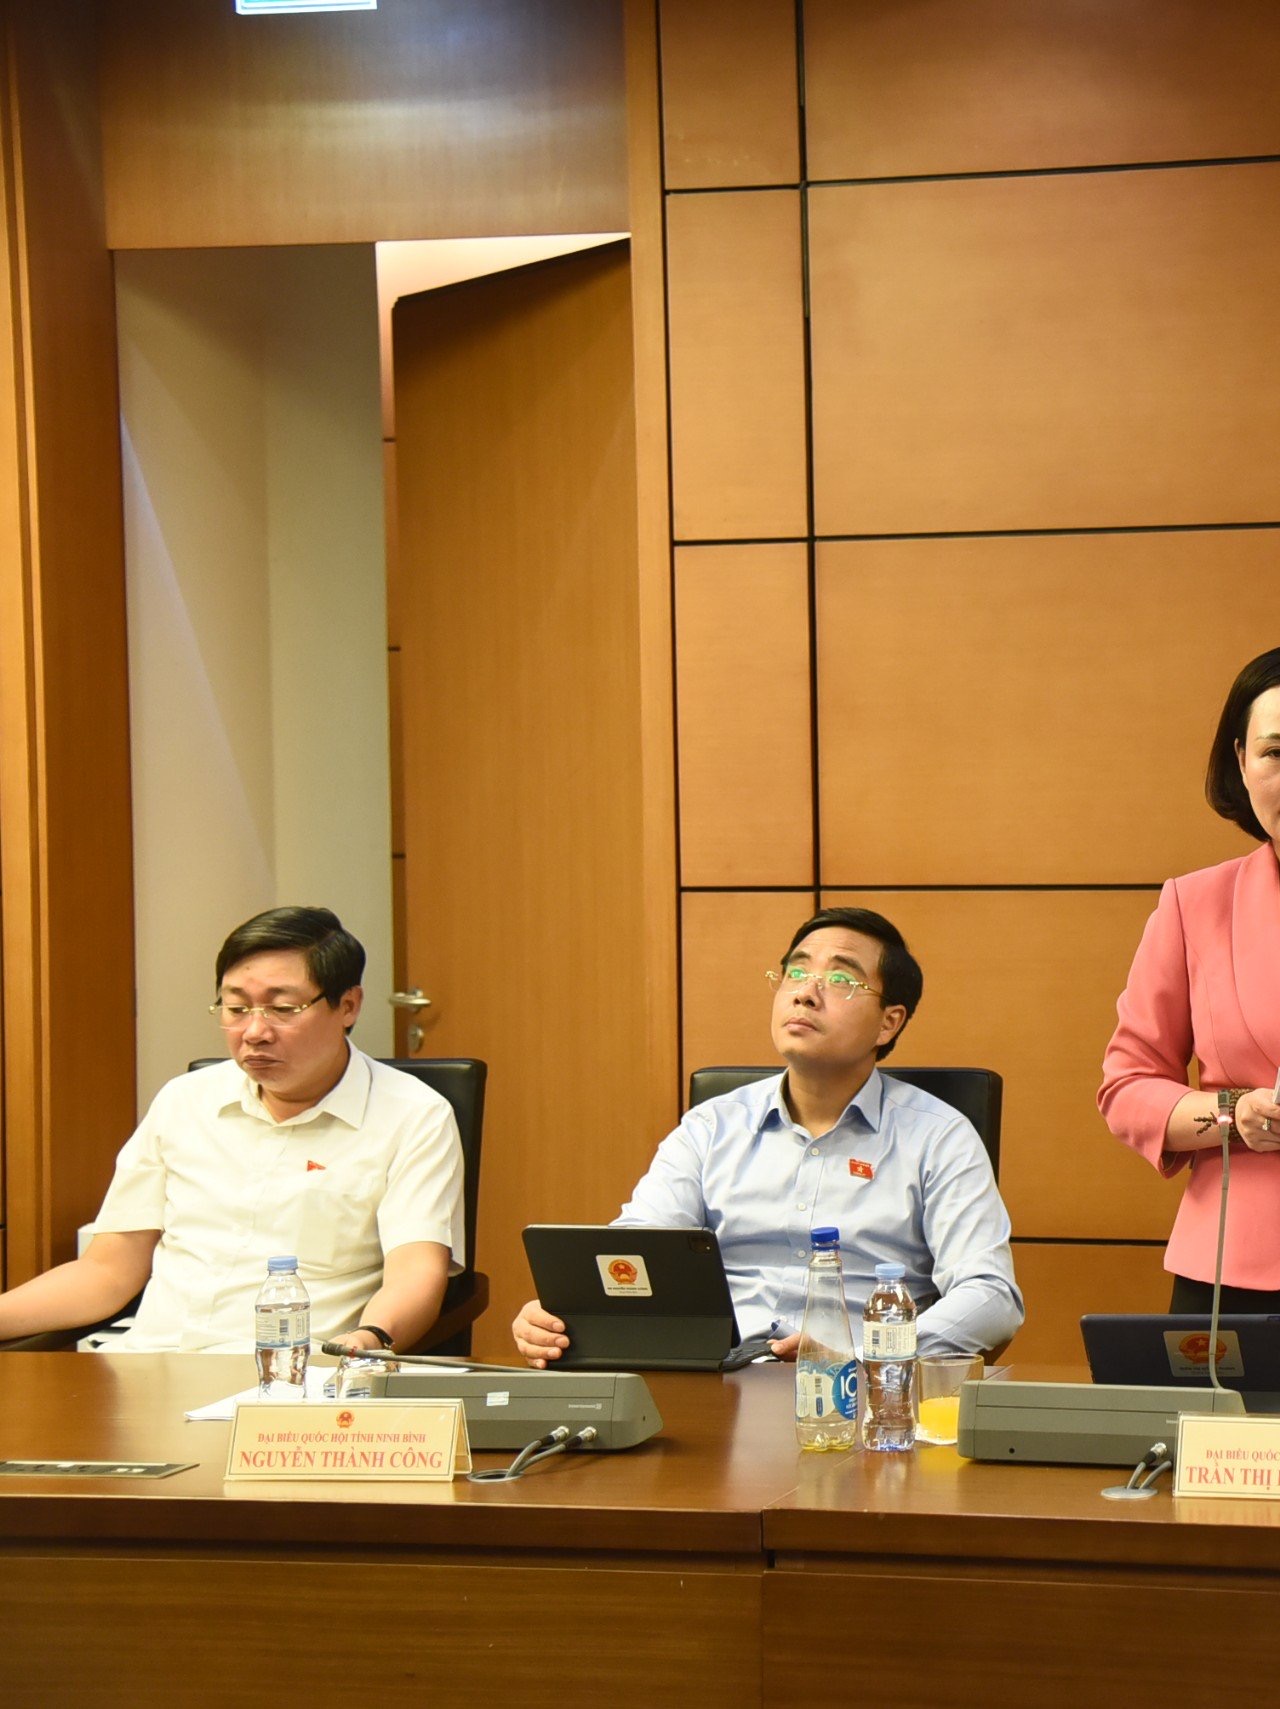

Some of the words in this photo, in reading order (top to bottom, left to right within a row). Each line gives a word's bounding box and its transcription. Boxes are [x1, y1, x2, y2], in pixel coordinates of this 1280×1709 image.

[257, 1433, 274, 1444] ĐẠI
[277, 1431, 300, 1443] BIỂU
[301, 1431, 329, 1445] QUỐC
[331, 1432, 348, 1445] HỘI
[351, 1431, 374, 1443] TỈNH
[376, 1433, 400, 1443] NINH
[402, 1431, 426, 1443] BÌNH
[239, 1446, 315, 1468] NGUYỄN
[321, 1446, 385, 1468] THÀNH
[390, 1446, 443, 1468] CÔNG
[1206, 1449, 1223, 1461] ĐẠI
[1226, 1448, 1249, 1460] BIỂU
[1251, 1449, 1280, 1463] QUỐC
[1186, 1459, 1235, 1485] TRẦN
[1240, 1467, 1272, 1490] THỊ
